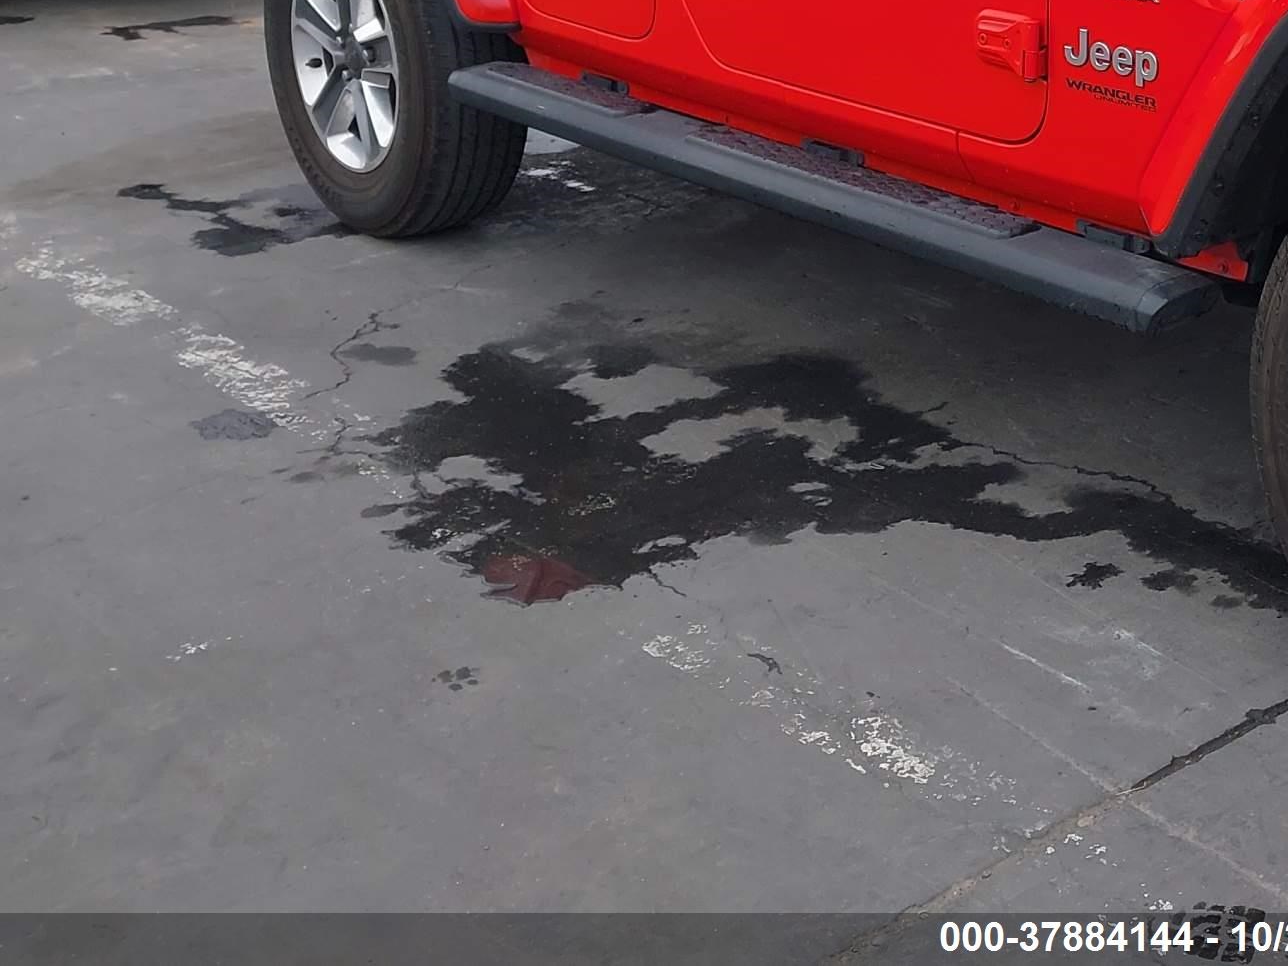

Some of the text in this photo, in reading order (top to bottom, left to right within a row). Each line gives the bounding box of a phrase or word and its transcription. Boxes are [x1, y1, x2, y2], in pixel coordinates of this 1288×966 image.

[1063, 27, 1159, 88] Jeep
[1066, 77, 1156, 107] WRANGLER
[1093, 93, 1157, 113] UNLIMITED
